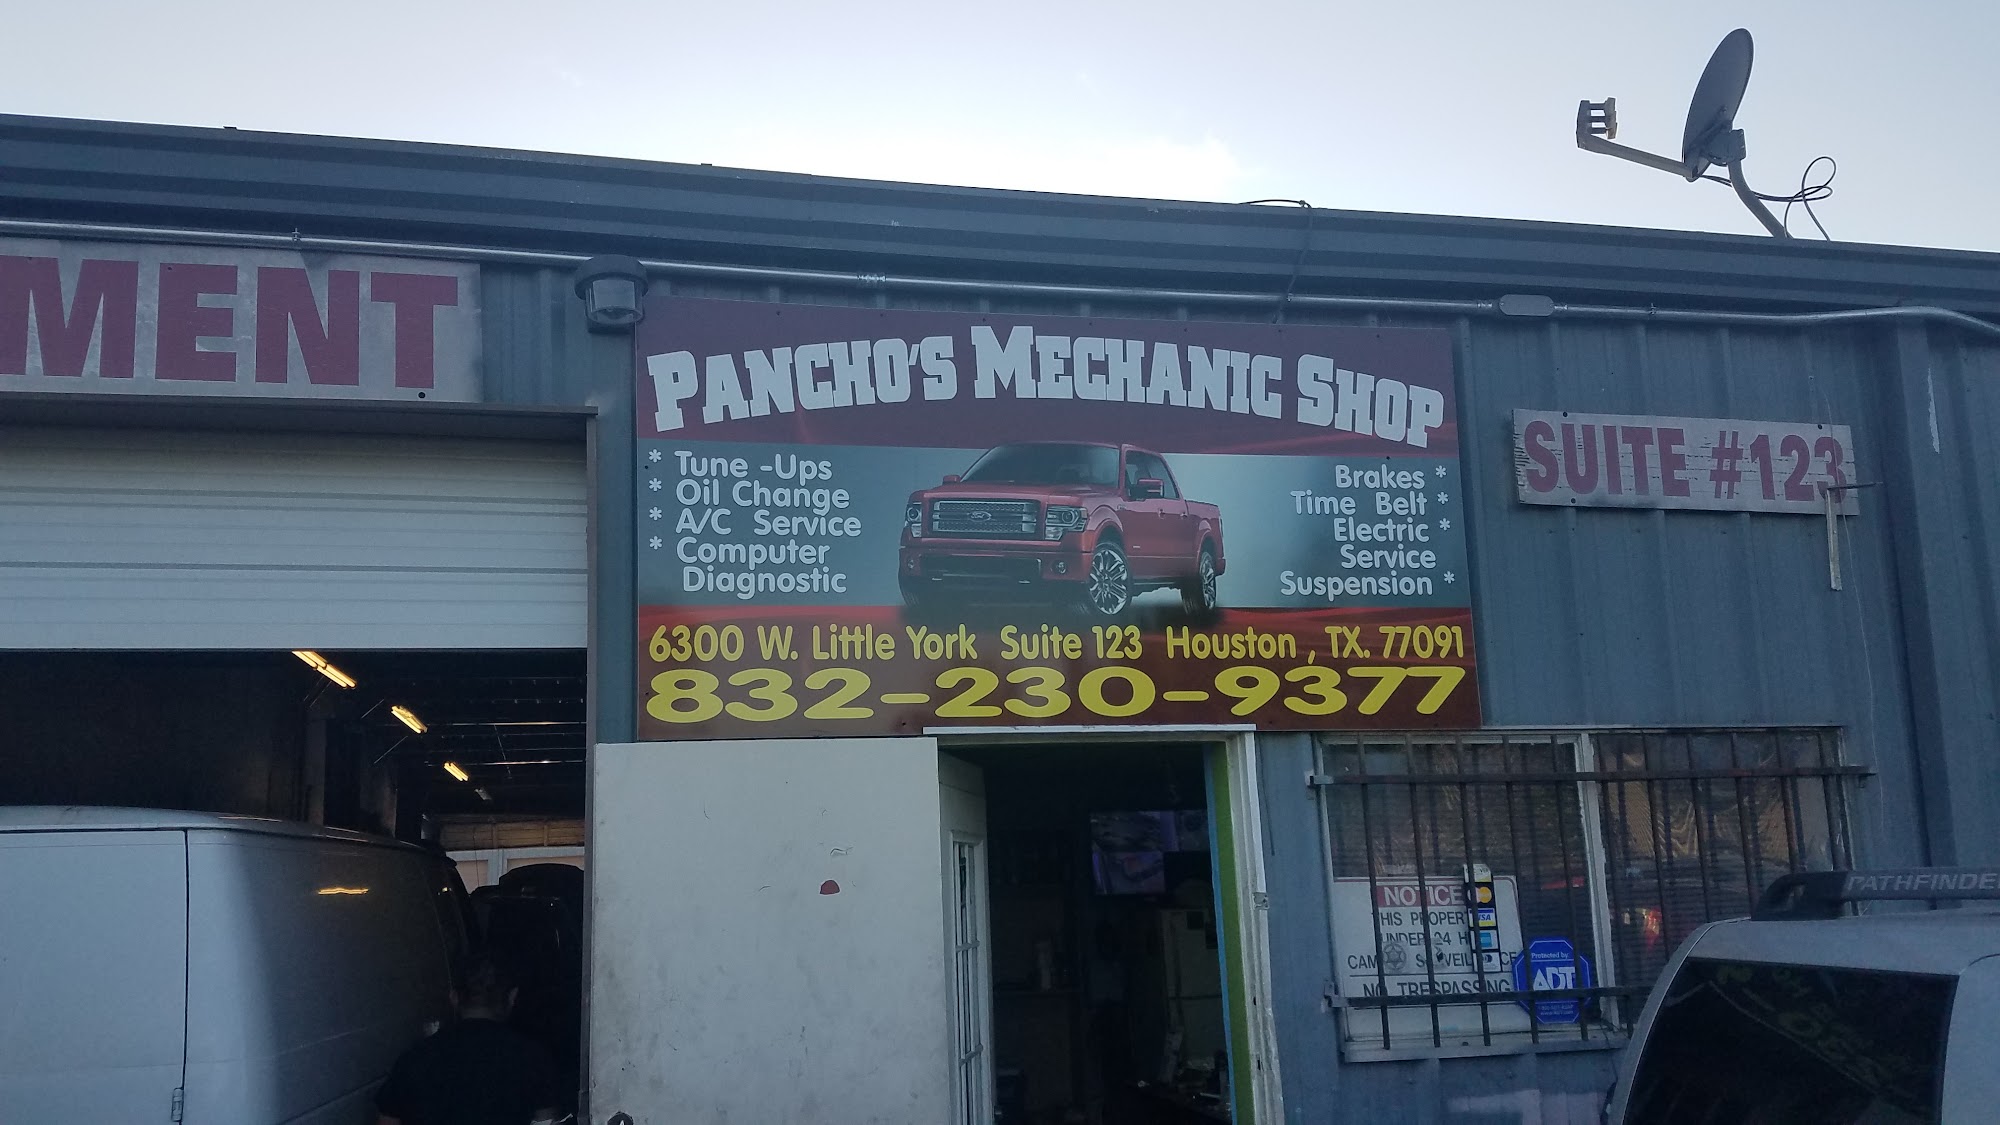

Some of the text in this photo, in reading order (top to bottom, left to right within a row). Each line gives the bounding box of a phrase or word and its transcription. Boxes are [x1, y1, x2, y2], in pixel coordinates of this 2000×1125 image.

[0, 254, 458, 389] MENT
[647, 325, 1444, 448] PANCHO'S MECHANIC SHOP
[675, 450, 748, 478] Tune
[1335, 464, 1425, 489] Brakes
[1523, 420, 1847, 504] SUITE #123
[675, 479, 850, 515] Oil Change
[1291, 490, 1427, 516] Time Belt
[675, 507, 862, 537] A/C Service
[1334, 517, 1430, 543] Electric
[676, 537, 831, 570] Computer
[1341, 544, 1437, 569] Service
[683, 565, 847, 600] Diagnostic
[1280, 570, 1433, 602] Suspension
[649, 624, 745, 662] 6300
[757, 625, 799, 661] W.
[812, 624, 896, 661] Little
[905, 624, 978, 661] York
[1000, 624, 1082, 661] Suite
[1092, 625, 1143, 660] 123
[1324, 625, 1370, 659] TX.
[1379, 625, 1464, 659] 77091
[646, 665, 1466, 723] 832-230-9377
[1847, 872, 2000, 891] PATHFINDE
[1372, 910, 1468, 926] HIS POPER
[1560, 951, 1569, 960] by
[1397, 979, 1511, 996] TRESPASSNG
[1533, 966, 1576, 991] ADT
